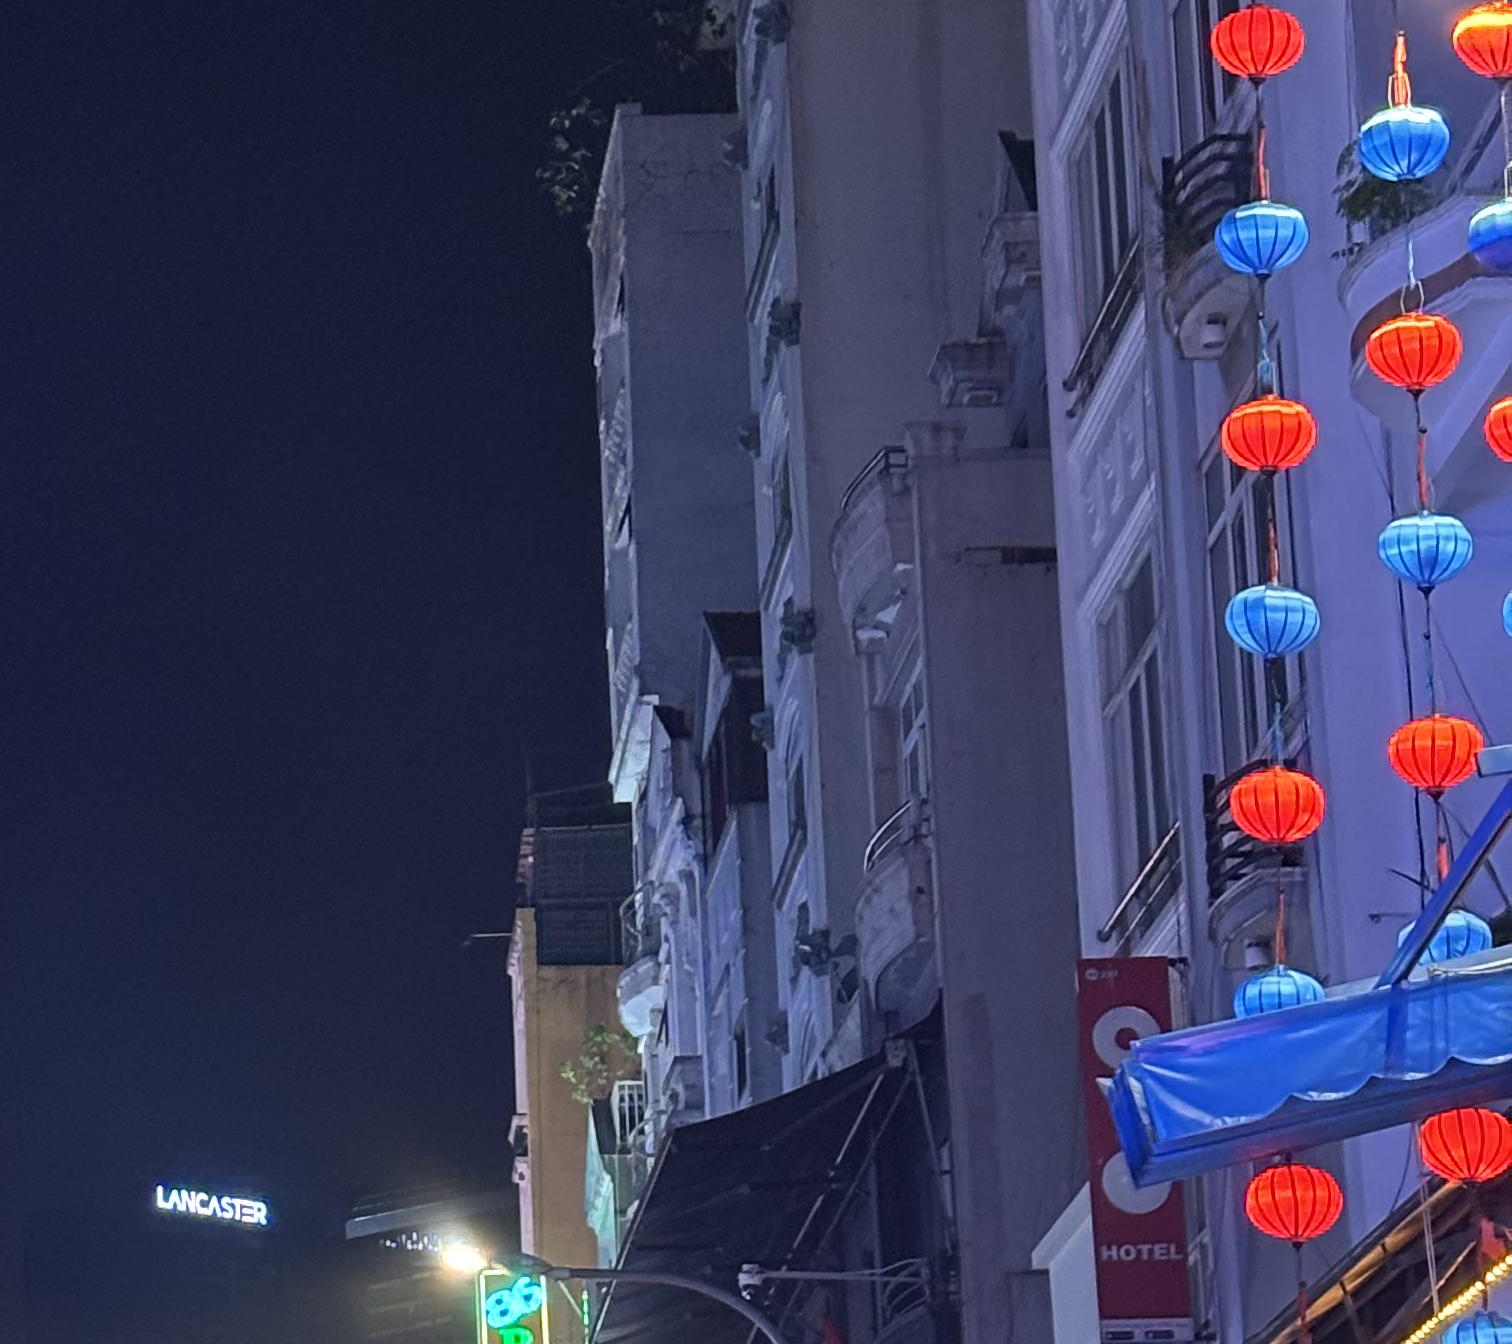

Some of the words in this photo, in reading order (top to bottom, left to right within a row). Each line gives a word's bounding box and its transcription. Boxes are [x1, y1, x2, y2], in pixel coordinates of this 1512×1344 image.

[155, 1185, 268, 1225] LANCASTER
[1101, 1243, 1183, 1261] HOTEL
[485, 1276, 543, 1327] 86
